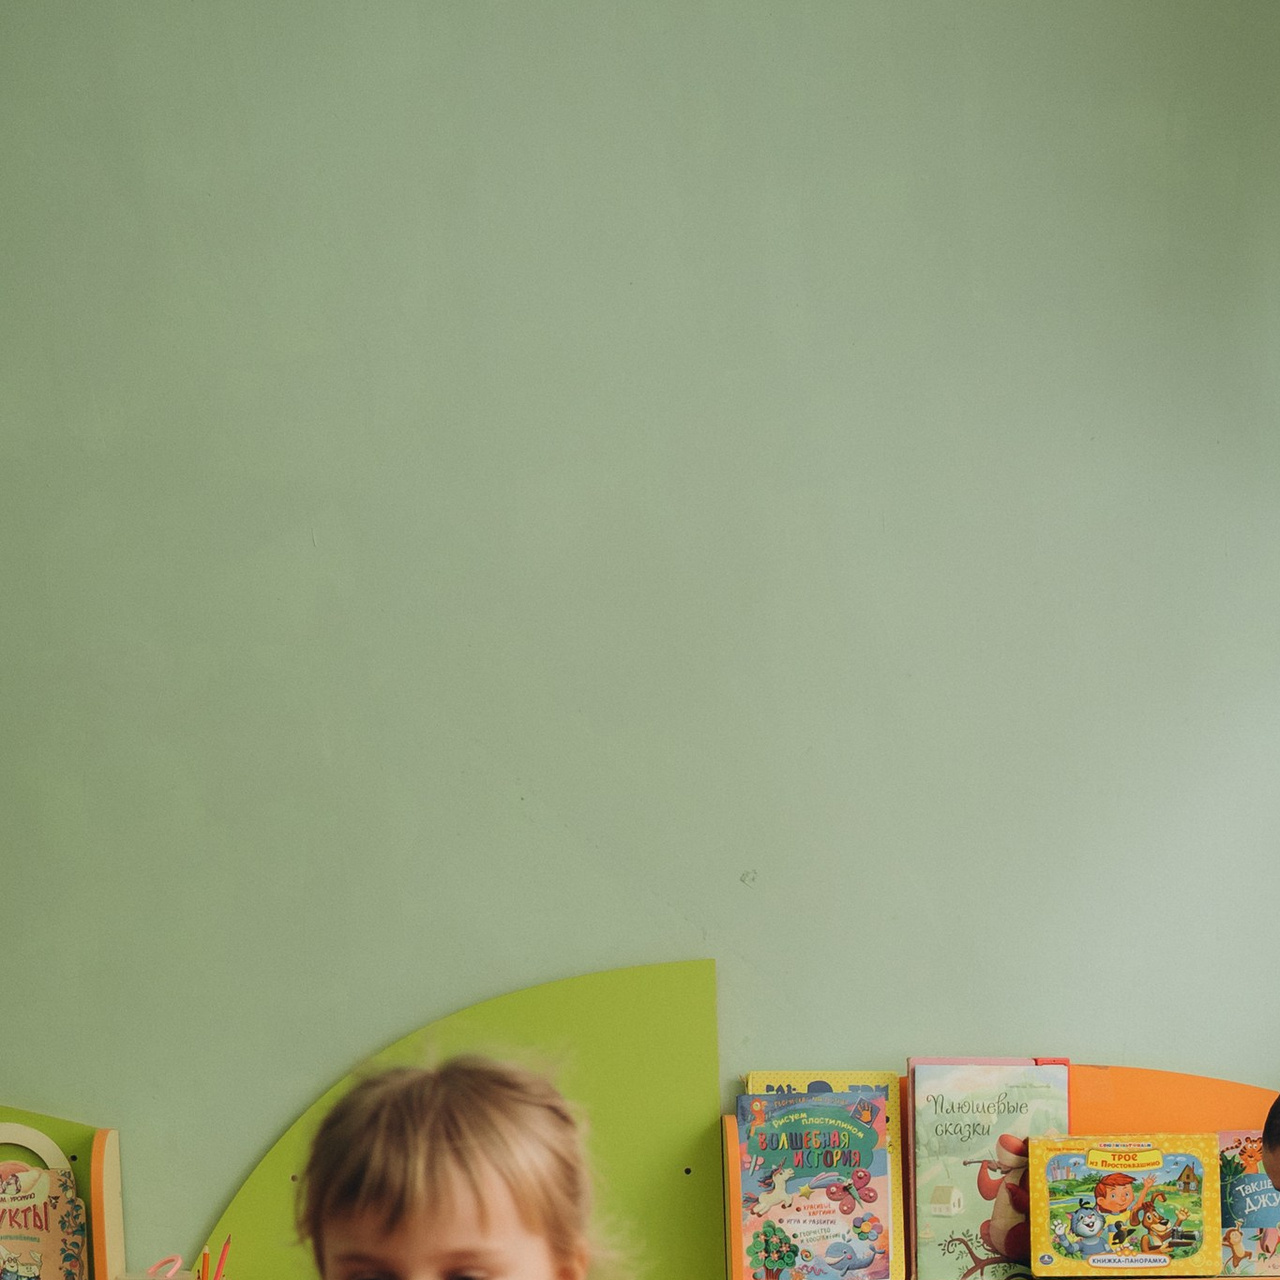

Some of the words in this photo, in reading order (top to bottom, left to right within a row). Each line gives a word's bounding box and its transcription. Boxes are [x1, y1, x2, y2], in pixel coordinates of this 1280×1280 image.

[926, 1092, 1029, 1116] Плюшевые
[801, 1118, 864, 1139] пластилином
[934, 1121, 991, 1143] сказки
[758, 1130, 850, 1151] ВОЛШЕБНАЯ
[794, 1150, 862, 1168] ИСТОРИЯ
[1091, 1257, 1167, 1265] КНИЖКА-ПАНОРАМКА
